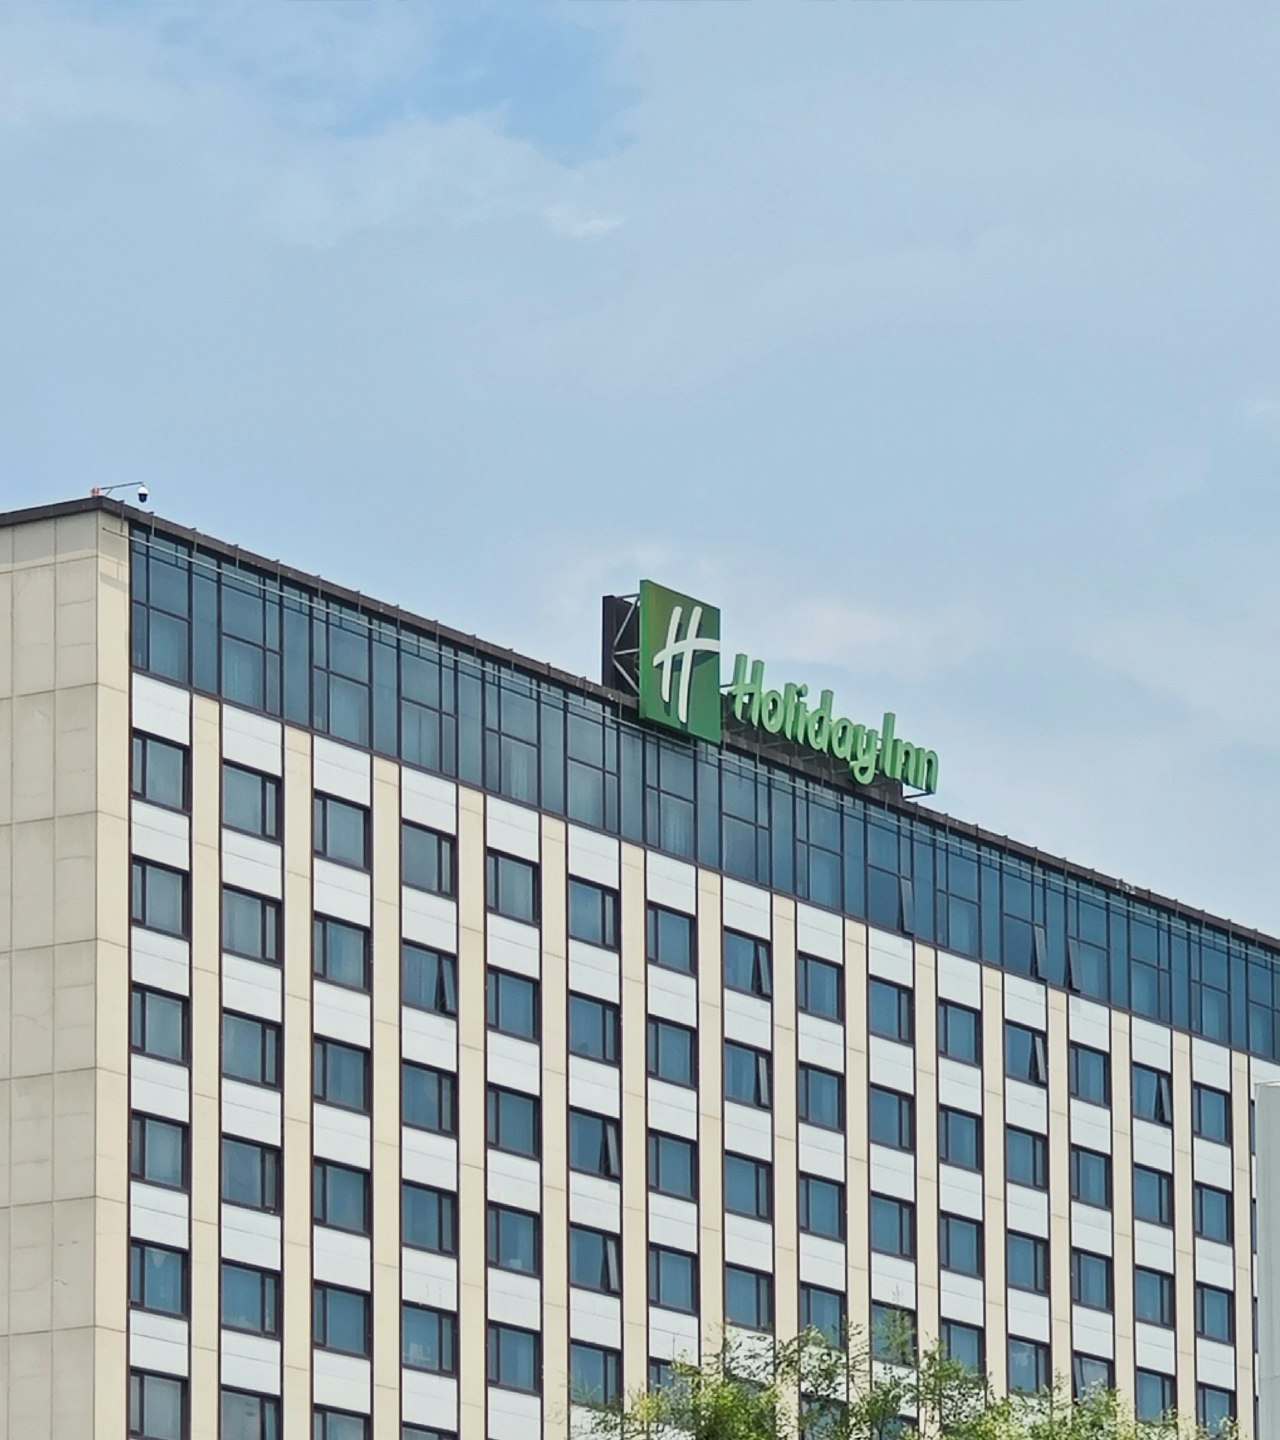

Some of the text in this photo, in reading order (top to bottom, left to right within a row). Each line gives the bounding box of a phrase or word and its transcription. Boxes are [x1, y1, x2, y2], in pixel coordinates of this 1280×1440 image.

[652, 606, 720, 723] H
[729, 653, 939, 794] Holiday Inn
